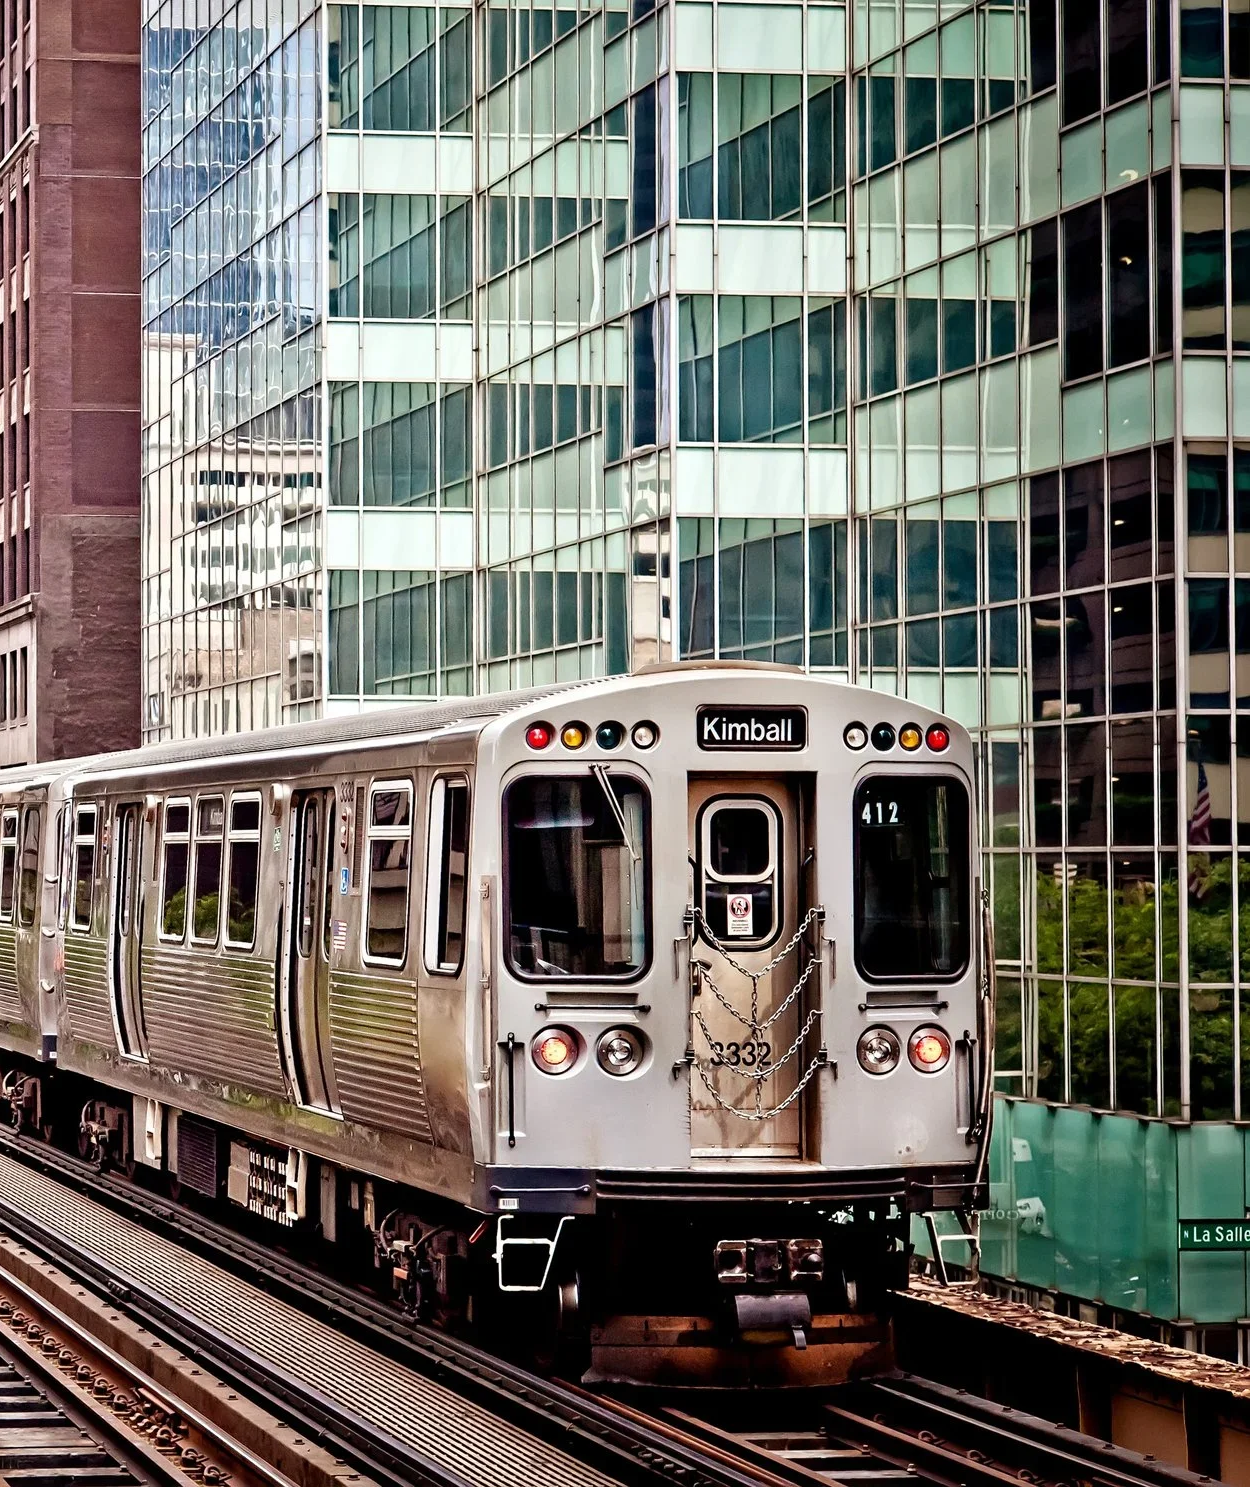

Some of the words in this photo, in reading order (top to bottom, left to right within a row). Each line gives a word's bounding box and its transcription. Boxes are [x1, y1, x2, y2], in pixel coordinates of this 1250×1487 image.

[703, 717, 792, 742] Kimball
[862, 802, 899, 825] 412
[710, 1041, 772, 1067] 3332
[1193, 1226, 1210, 1242] La
[1215, 1226, 1250, 1242] Salle
